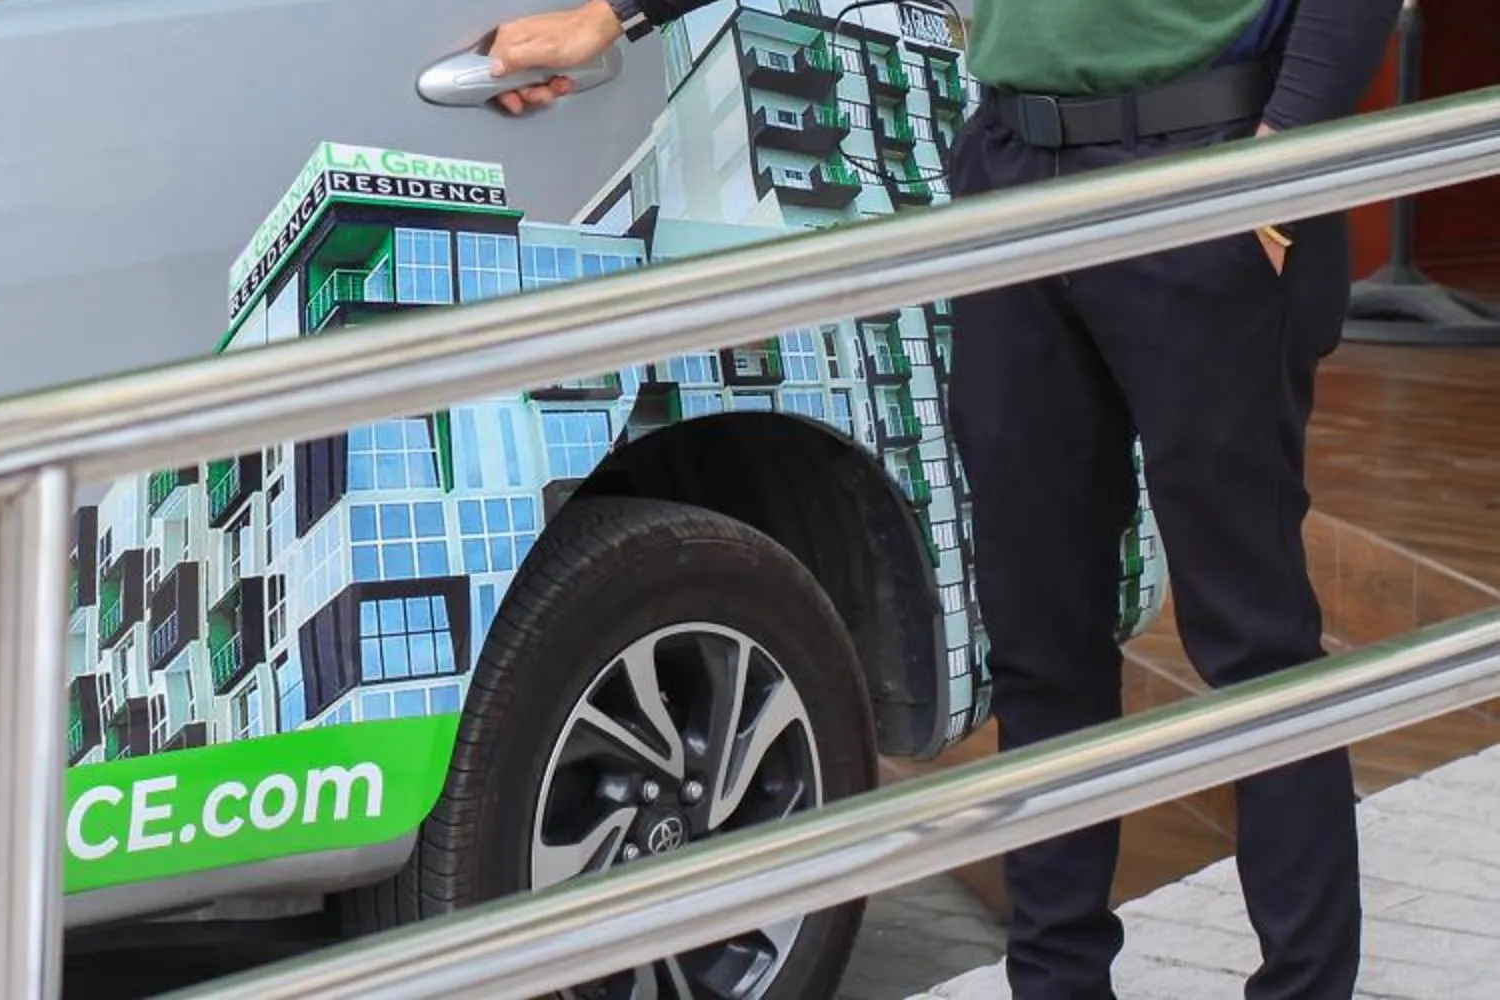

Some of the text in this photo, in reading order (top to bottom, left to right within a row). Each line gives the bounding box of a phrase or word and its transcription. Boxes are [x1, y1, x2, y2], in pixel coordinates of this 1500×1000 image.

[324, 143, 502, 184] LA GRANDE
[332, 173, 503, 205] RESIDENCE
